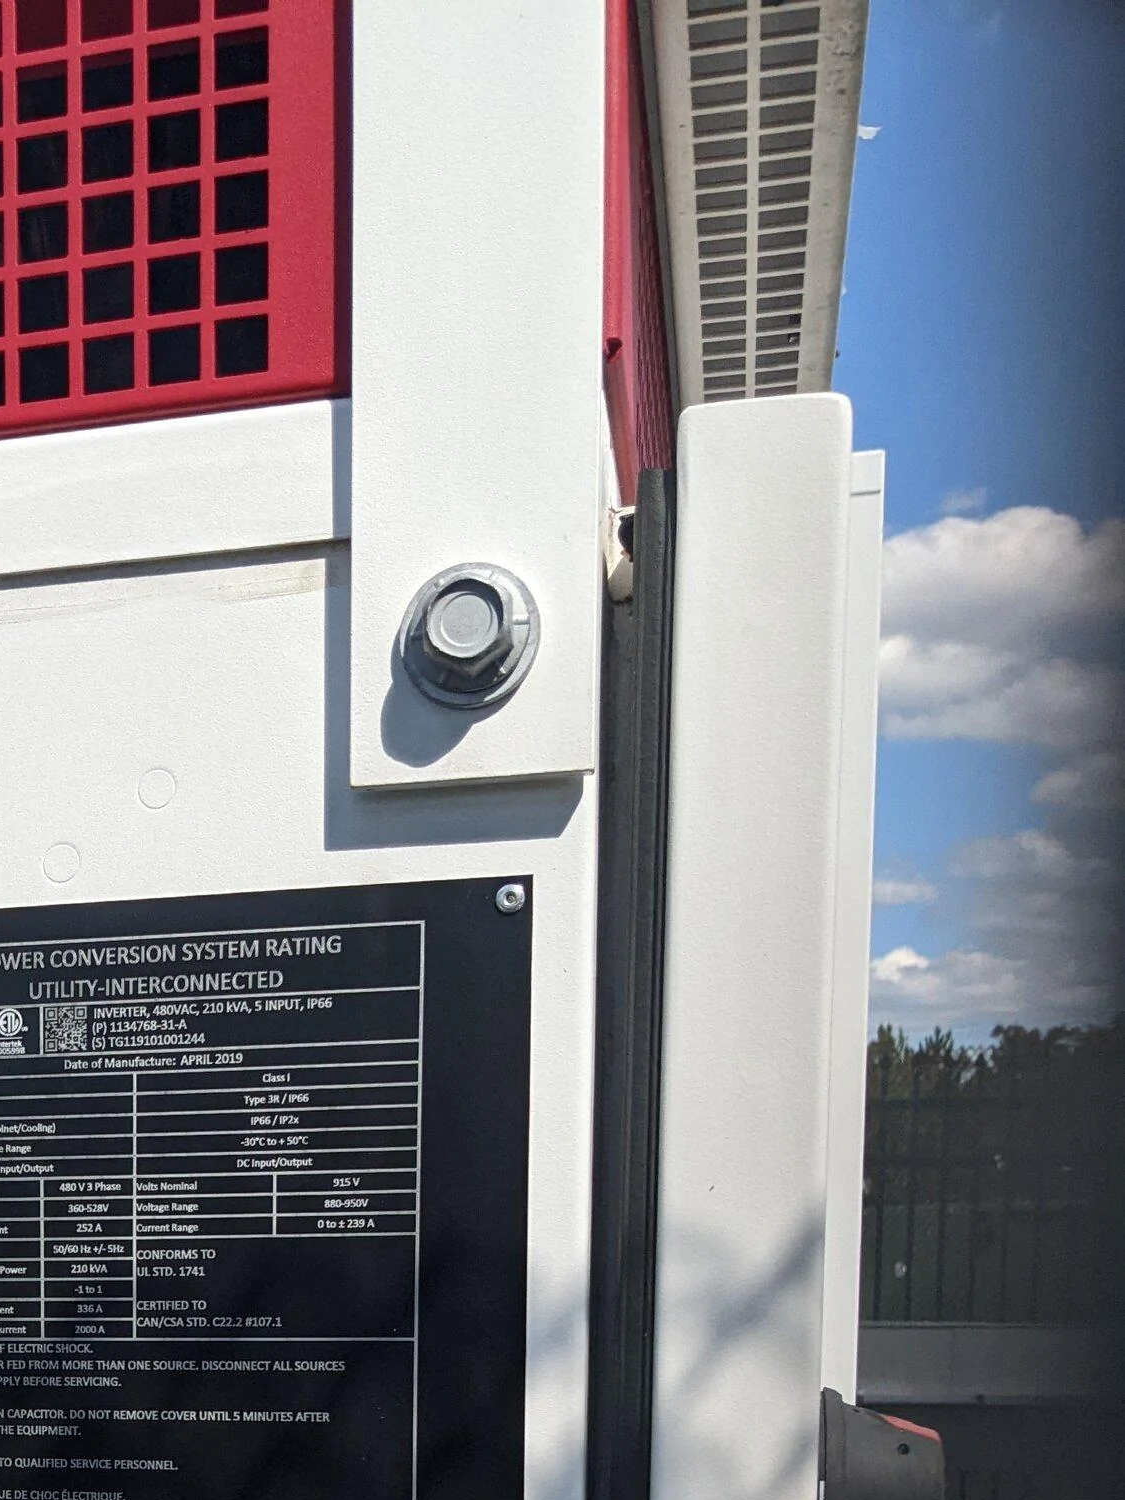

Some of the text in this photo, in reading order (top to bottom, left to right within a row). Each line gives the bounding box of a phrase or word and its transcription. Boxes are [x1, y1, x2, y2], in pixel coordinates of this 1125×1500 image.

[49, 944, 176, 967] CONVERSION
[181, 940, 259, 960] SYSTEM
[265, 935, 341, 956] RATING
[29, 970, 283, 998] UTILITY-INTERCONNECTED
[93, 1006, 150, 1018] INVERTER,
[152, 1003, 199, 1016] 480VAC,
[202, 1002, 223, 1014] 210
[226, 1000, 252, 1013] kVA,
[264, 998, 304, 1011] INPUT,
[306, 996, 332, 1009] IP66
[91, 1018, 187, 1036] (P) 1134768-31-A
[91, 1033, 205, 1050] (S) TG119101001244
[63, 1052, 243, 1069] Date of Manufacture: APRIL 2019
[261, 1072, 285, 1082] Class
[5, 1144, 31, 1154] Range
[236, 1157, 313, 1168] DC Input/Output
[59, 1182, 76, 1192] 480
[86, 1181, 93, 1191] 3
[94, 1181, 121, 1191] Phase
[136, 1181, 197, 1191] Volts Nominal
[67, 1203, 109, 1212] 360-528V
[136, 1202, 198, 1213] Voltage Range
[323, 1198, 369, 1208] 880-950V
[75, 1222, 93, 1232] 252
[136, 1223, 199, 1233] Current Range
[136, 1248, 216, 1259] CONFORMS TO
[0, 1265, 27, 1274] Power
[70, 1263, 107, 1273] 210 kVA
[136, 1266, 205, 1276] UL STD. 1741
[136, 1299, 207, 1310] CERTIFIED TO
[136, 1316, 282, 1328] CAN/CSA STD. C22.2 #107.1
[7, 1343, 53, 1353] ELECTRIC
[55, 1343, 93, 1353] SHOCK.
[6, 1359, 25, 1369] FED
[28, 1359, 59, 1369] FROM
[61, 1360, 93, 1370] MORE
[95, 1360, 125, 1370] THAN
[127, 1360, 151, 1370] ONE
[152, 1360, 198, 1370] SOURCE.
[201, 1360, 271, 1370] DISCONNECT
[272, 1360, 292, 1371] ALL
[294, 1360, 345, 1371] SOURCES
[22, 1376, 62, 1386] BEFORE
[63, 1376, 122, 1386] SERVICING.
[6, 1408, 67, 1419] CAPACITOR.
[69, 1409, 85, 1419] DO
[88, 1409, 111, 1419] NOT
[113, 1409, 158, 1420] REMOVE
[160, 1410, 197, 1420] COVER
[198, 1410, 231, 1421] UNTIL
[242, 1411, 293, 1421] MINUTES
[294, 1411, 329, 1422] AFTER
[16, 1424, 81, 1435] EQUIPMENT.
[14, 1457, 67, 1468] QUALIFIED
[69, 1458, 111, 1468] SERVICE
[113, 1459, 178, 1470] PERSONNEL.
[13, 1489, 27, 1500] DE
[29, 1490, 59, 1500] CHOC
